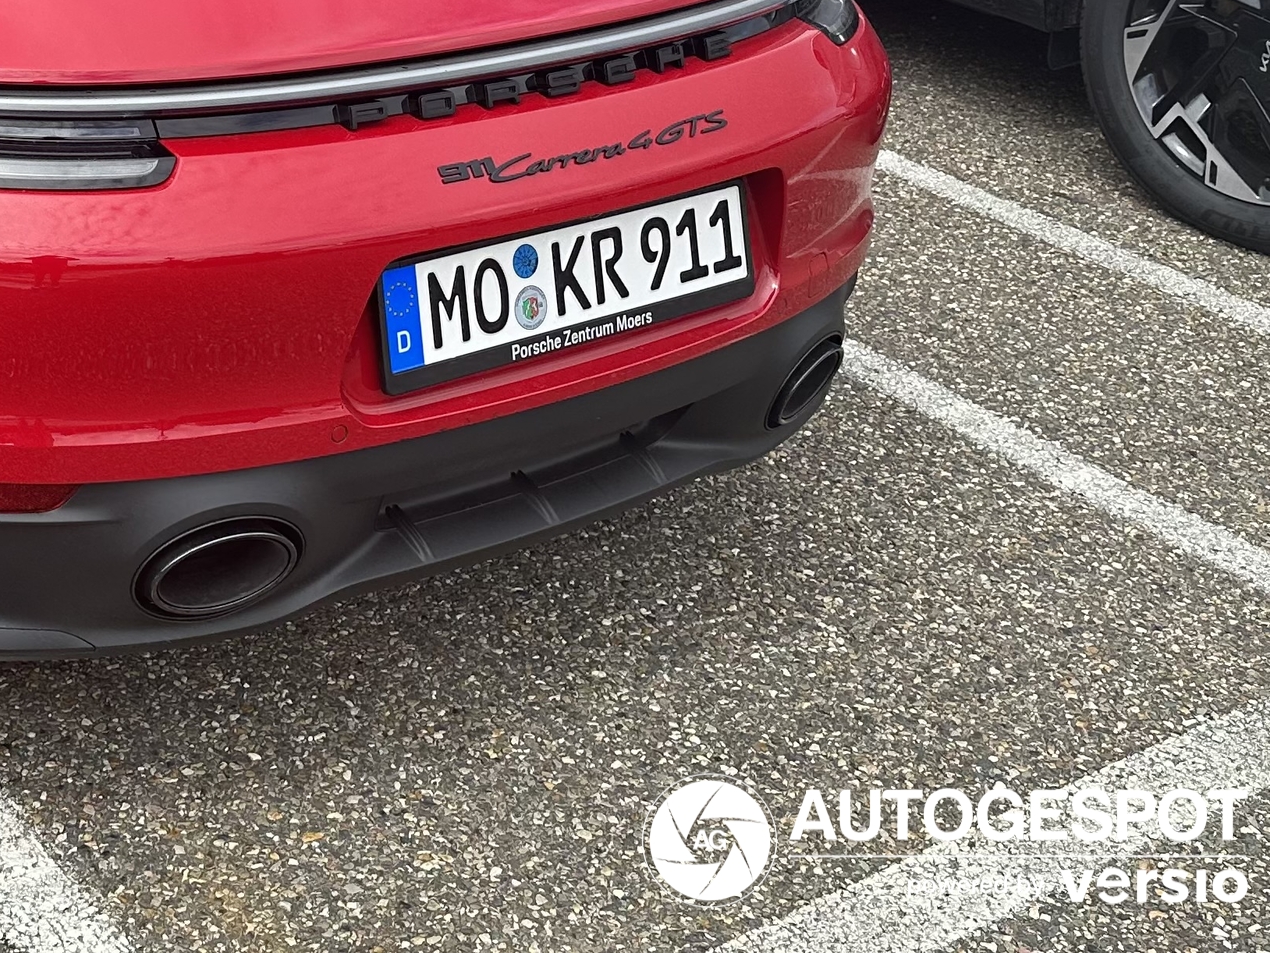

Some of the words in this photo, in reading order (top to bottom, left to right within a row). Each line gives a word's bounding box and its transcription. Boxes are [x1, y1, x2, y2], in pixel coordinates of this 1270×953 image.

[340, 31, 733, 130] PORSCHE
[488, 142, 627, 183] Carrera
[655, 109, 728, 146] GTS
[427, 257, 510, 350] MO
[551, 226, 630, 316] KR
[640, 199, 743, 291] 911
[396, 330, 412, 354] D
[511, 335, 562, 361] Porsche
[563, 322, 614, 347] Zentrum
[616, 311, 653, 332] Moers
